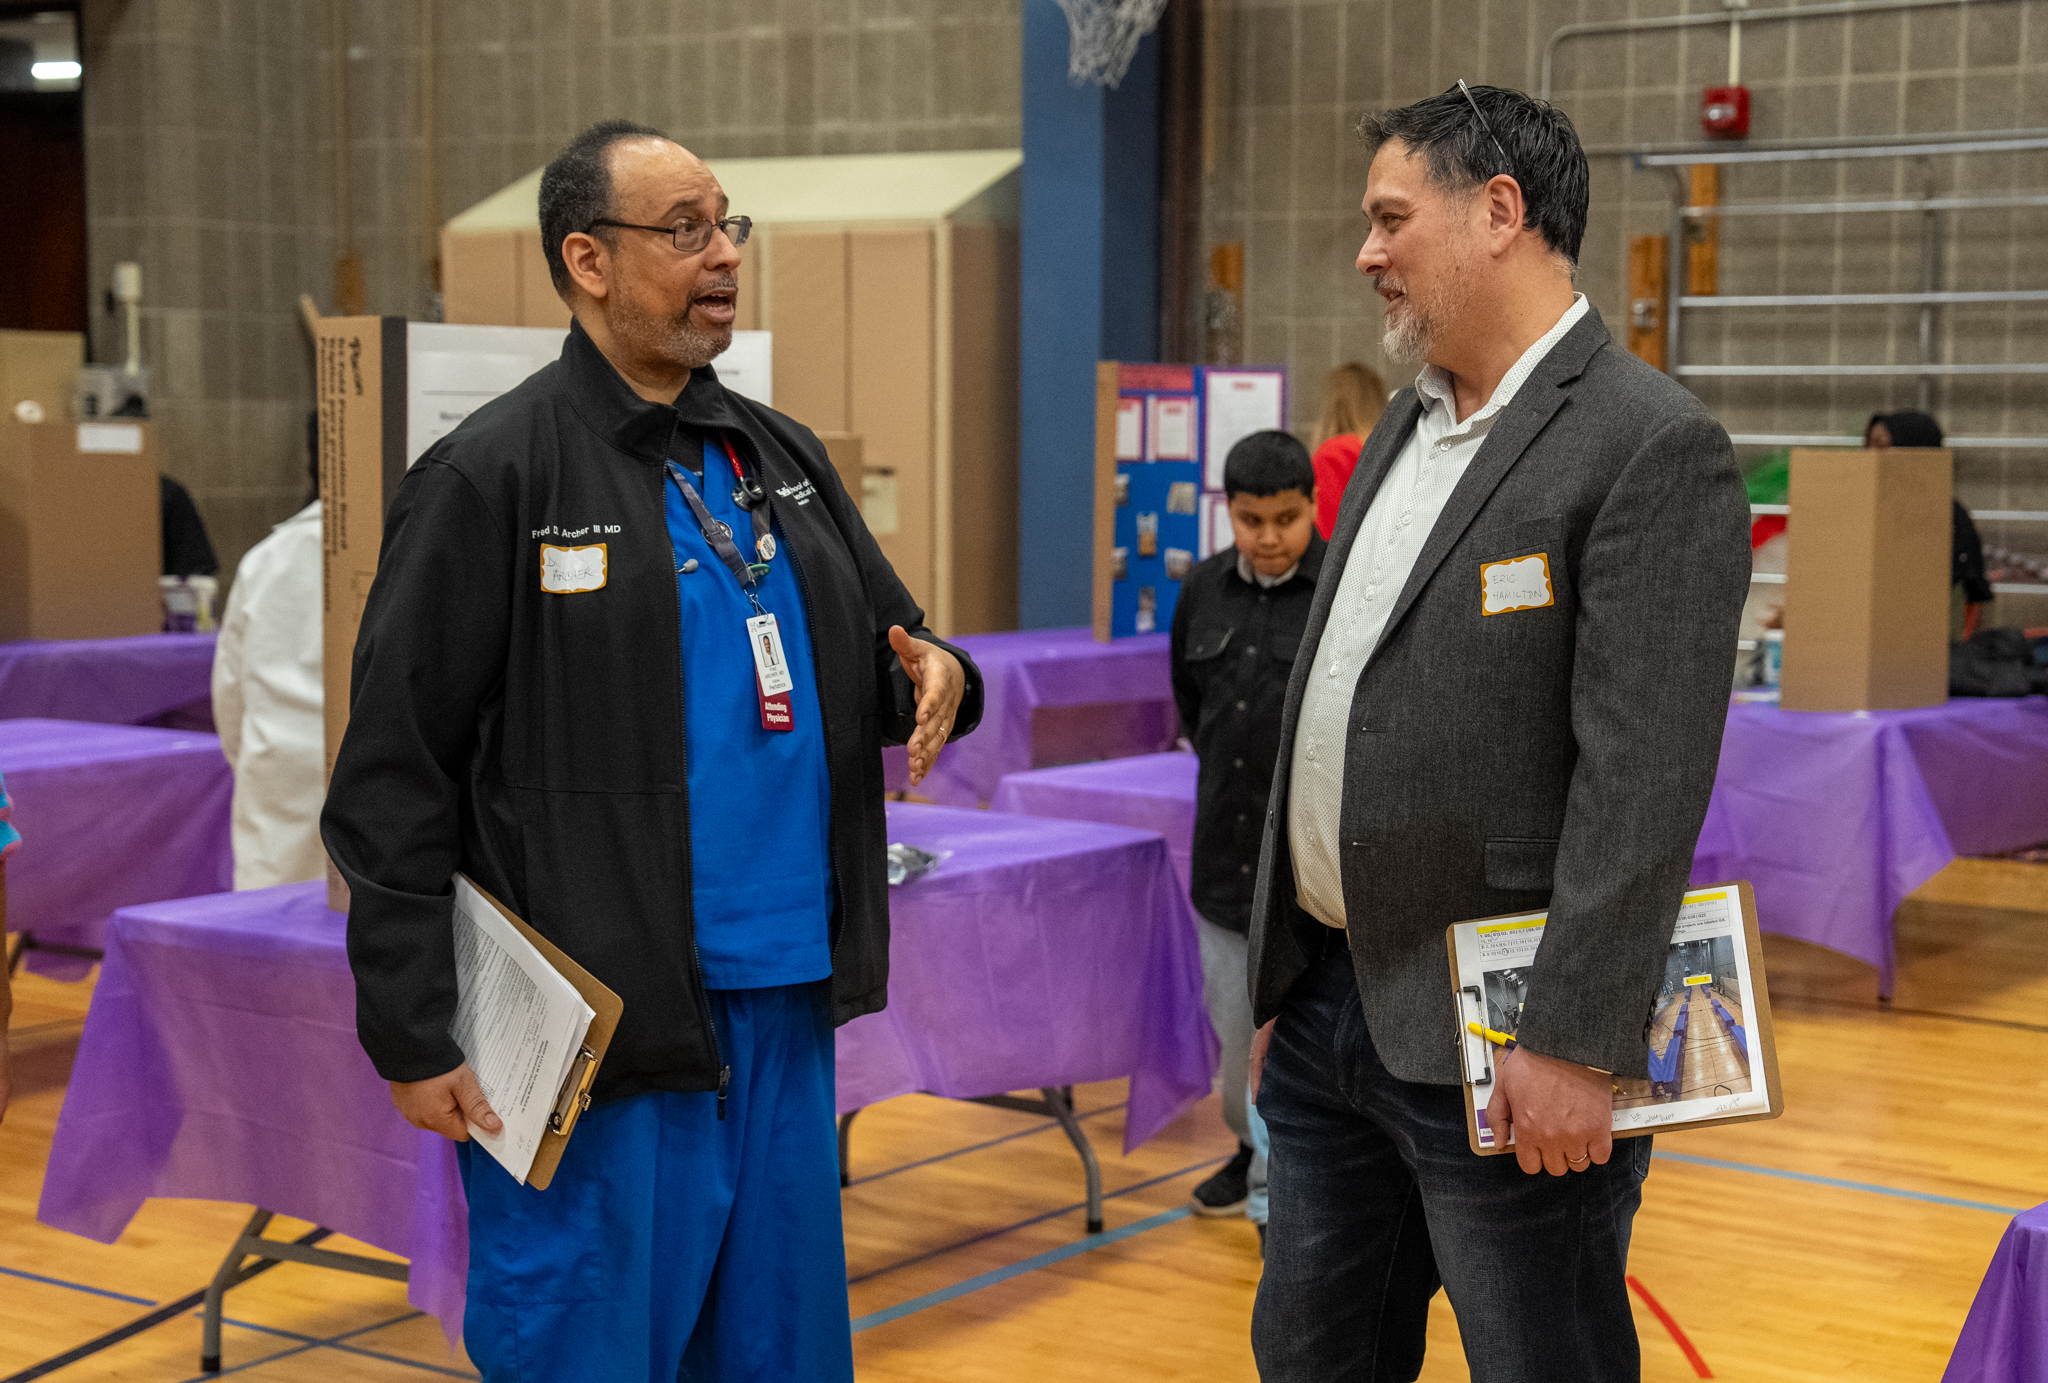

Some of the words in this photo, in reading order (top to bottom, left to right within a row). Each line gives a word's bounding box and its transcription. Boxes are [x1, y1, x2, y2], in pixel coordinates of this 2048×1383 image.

[532, 526, 550, 539] Fred
[553, 526, 559, 535] D.
[562, 527, 589, 538] Archer
[604, 525, 621, 533] MD
[553, 566, 593, 582] ARCHER
[1493, 574, 1515, 584] ERIC
[1493, 584, 1542, 601] HAMILTON
[765, 702, 787, 713] Attending
[767, 713, 790, 724] Physician
